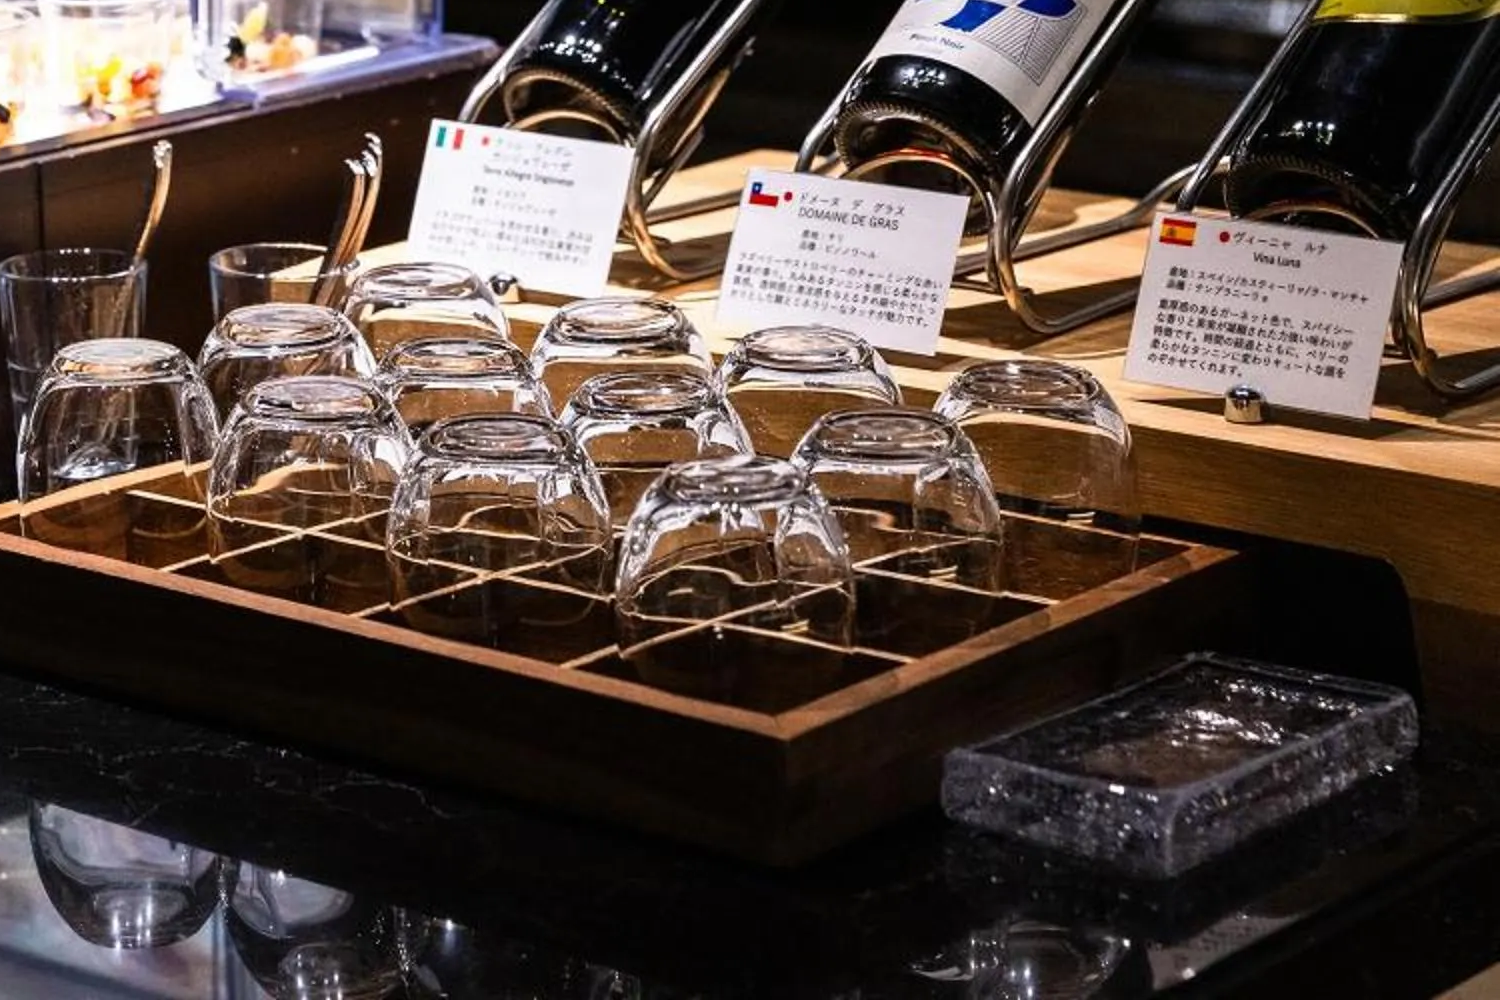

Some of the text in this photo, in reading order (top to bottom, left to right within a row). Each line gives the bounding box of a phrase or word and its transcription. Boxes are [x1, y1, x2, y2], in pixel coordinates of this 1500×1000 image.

[798, 207, 899, 231] DOMAINE DE GRAS
[1233, 231, 1329, 255] ヴィーニャ ルナ
[1277, 254, 1302, 269] Luna
